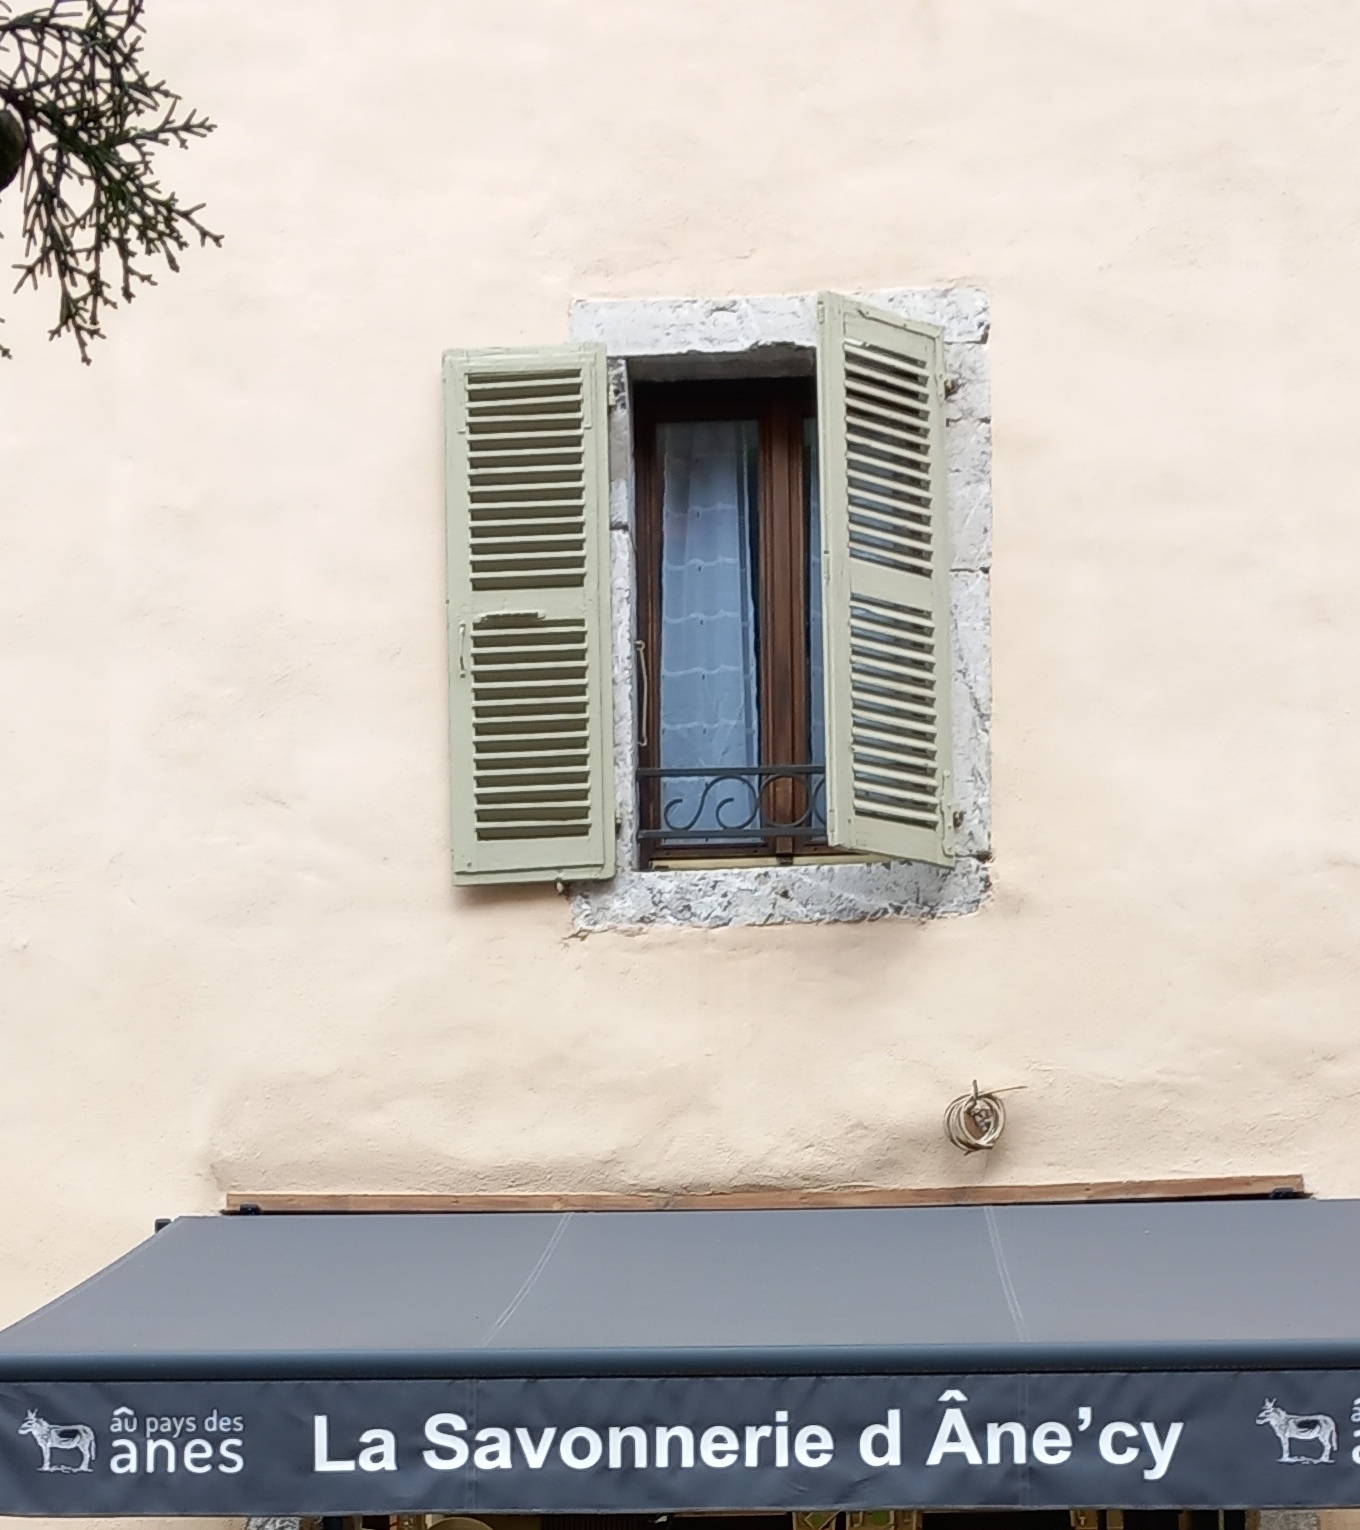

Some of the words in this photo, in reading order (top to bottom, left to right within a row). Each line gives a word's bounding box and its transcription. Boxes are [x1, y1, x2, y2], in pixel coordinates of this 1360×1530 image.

[145, 1416, 197, 1439] pays
[204, 1408, 244, 1432] des
[313, 1414, 398, 1473] La
[422, 1410, 835, 1471] Savonnerie
[858, 1408, 902, 1467] d
[109, 1438, 245, 1474] anes
